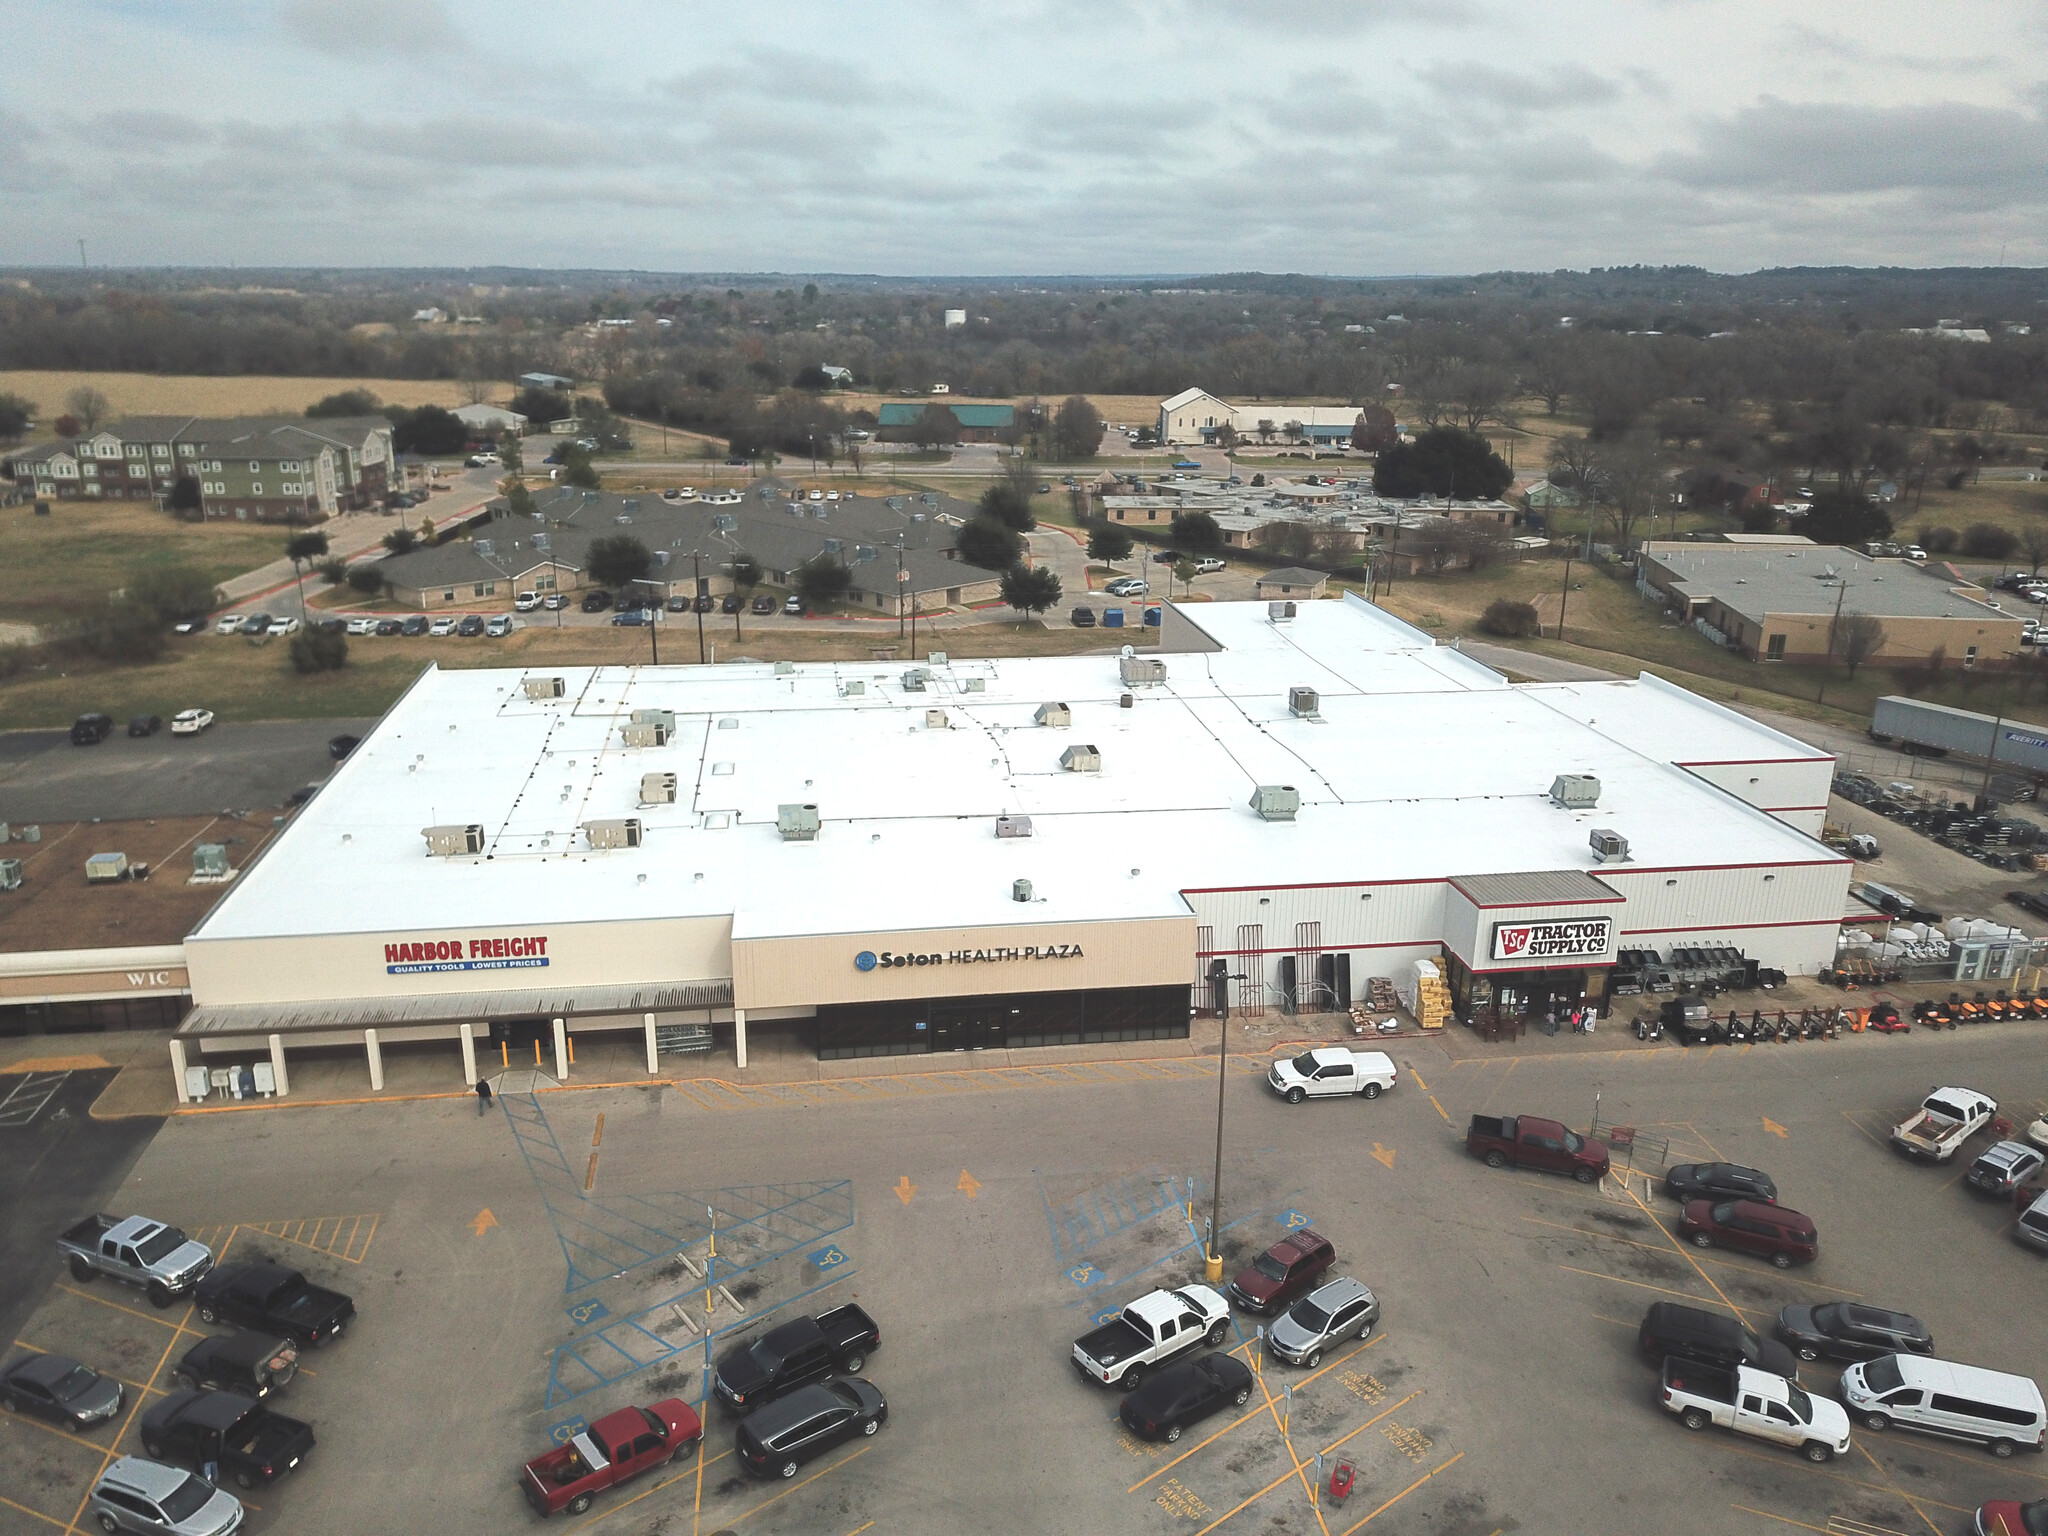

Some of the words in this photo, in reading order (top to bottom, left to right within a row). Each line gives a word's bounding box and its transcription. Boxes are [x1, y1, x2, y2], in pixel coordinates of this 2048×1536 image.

[2008, 734, 2045, 746] AVERITT
[1503, 930, 1525, 950] TSC
[1531, 922, 1606, 940] TRACTOR
[384, 941, 463, 962] HARBOR
[469, 936, 548, 959] FREIGHT
[880, 952, 943, 968] Seton
[949, 947, 1019, 964] HEALTH
[1024, 944, 1084, 960] PLAZA
[1528, 939, 1588, 956] SUPPLY
[394, 965, 433, 974] QUALITY
[435, 963, 465, 971] TOOLS
[472, 961, 507, 969] LOWEST
[509, 959, 542, 967] PRICES
[126, 971, 170, 986] WIC
[1335, 1375, 1379, 1406] PATIENT
[1344, 1370, 1386, 1401] PARKING
[1360, 1373, 1387, 1391] ONLY
[1116, 1438, 1143, 1457] ONLY
[1380, 1428, 1422, 1464] PATIENT
[1389, 1422, 1429, 1457] PARKING
[1406, 1427, 1433, 1448] ONLY
[1158, 1484, 1201, 1521] PARKING
[1167, 1478, 1213, 1514] PATIENT
[1156, 1496, 1183, 1518] ONLY
